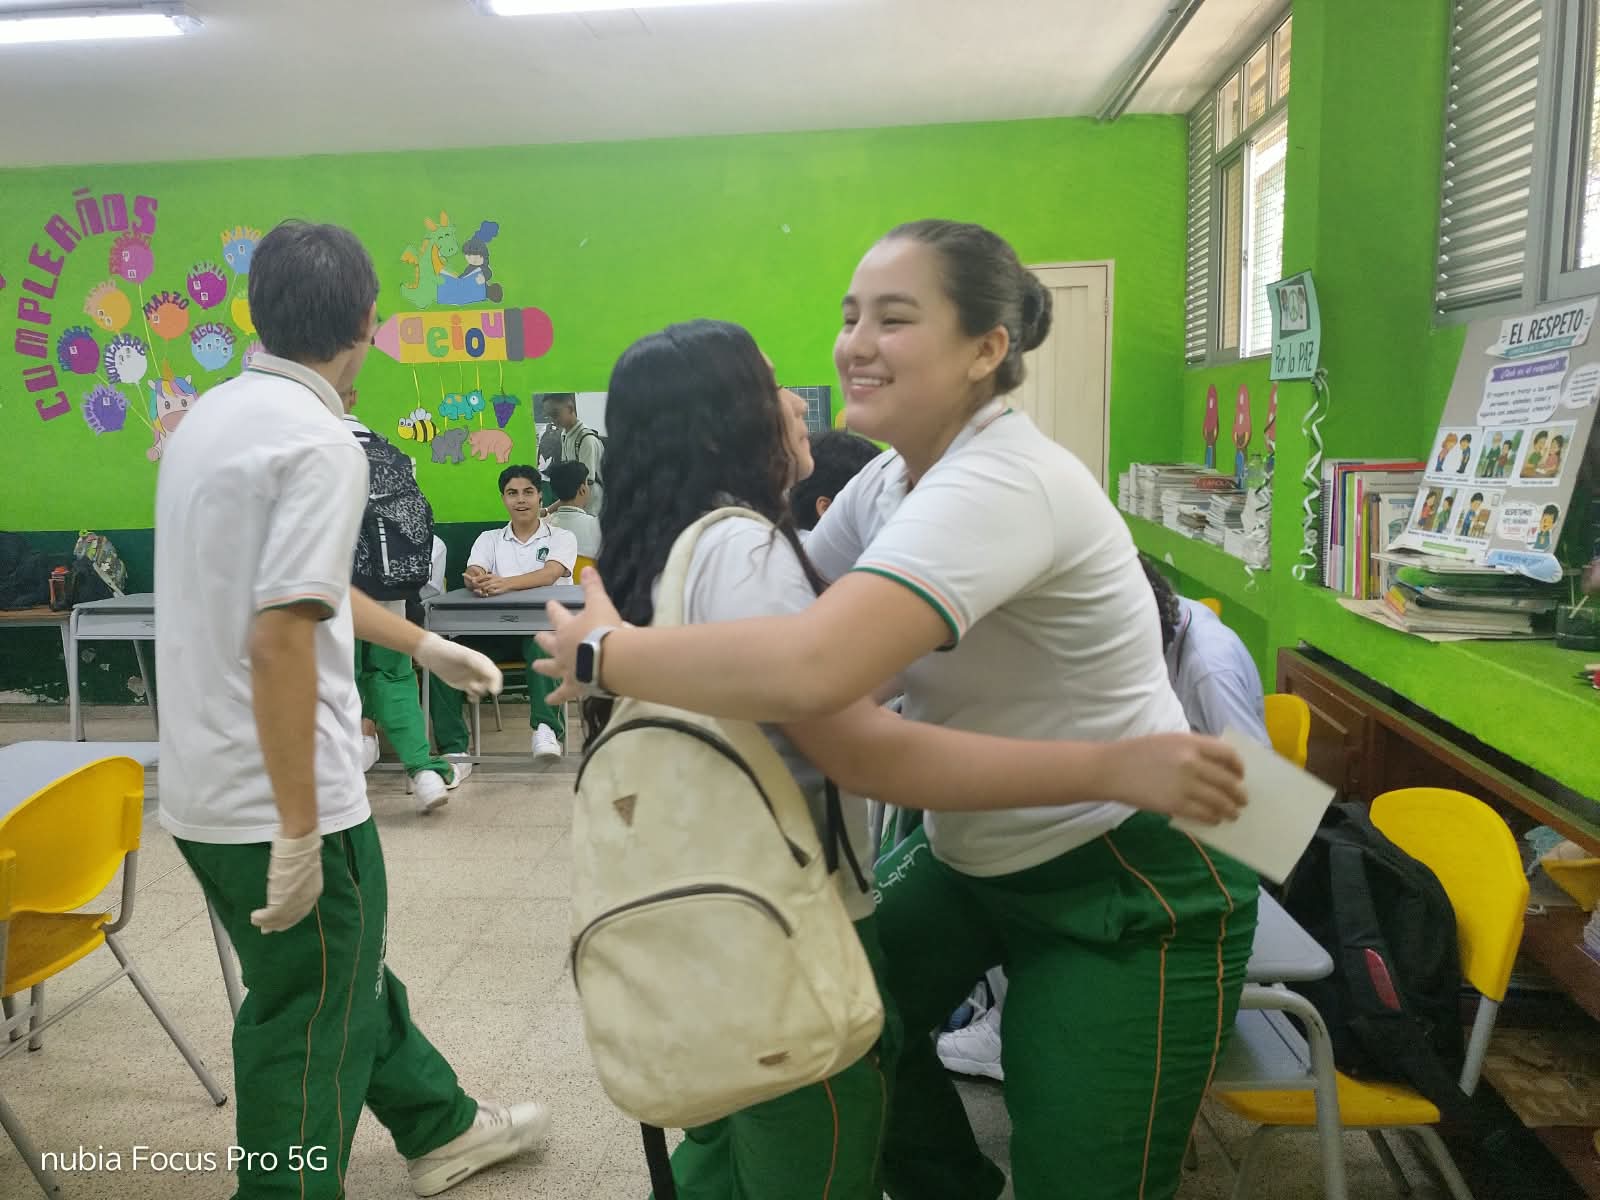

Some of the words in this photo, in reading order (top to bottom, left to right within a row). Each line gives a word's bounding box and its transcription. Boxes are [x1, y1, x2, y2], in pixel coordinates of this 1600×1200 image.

[15, 187, 158, 421] CUMPLEAÑOS
[143, 291, 189, 321] MARZO
[190, 322, 237, 345] AGOSTO
[401, 312, 504, 358] aeiou
[1509, 322, 1524, 345] EL
[1528, 308, 1584, 342] RESPETO
[1275, 344, 1286, 373] Por
[1298, 340, 1315, 373] PAZ
